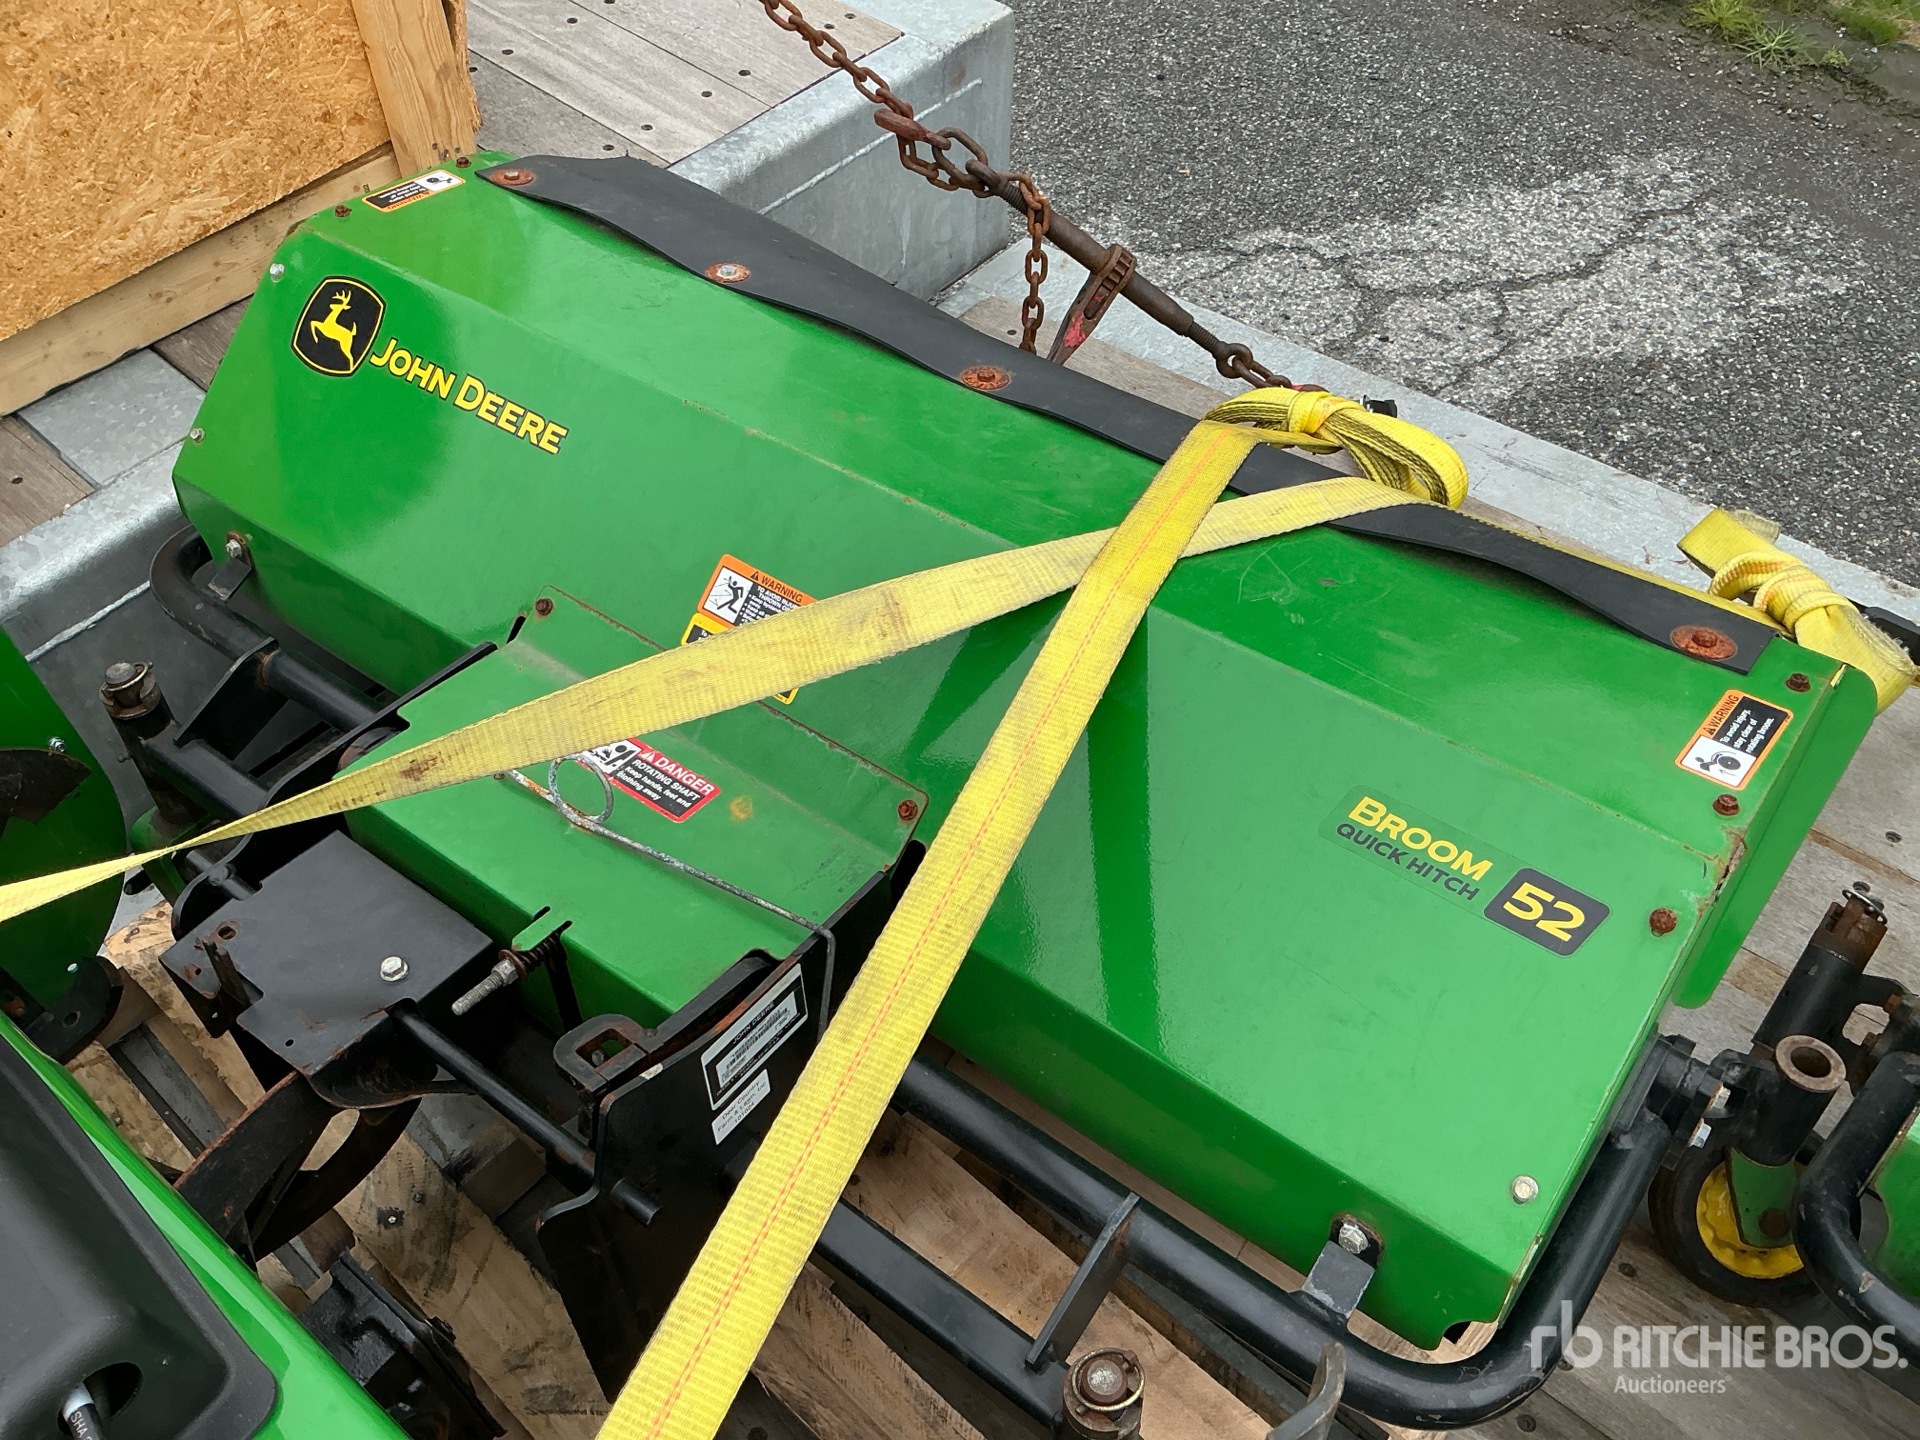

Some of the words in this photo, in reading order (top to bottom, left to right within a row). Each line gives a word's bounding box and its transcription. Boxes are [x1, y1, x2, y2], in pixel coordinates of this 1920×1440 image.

[369, 337, 457, 401] JOHN
[453, 374, 569, 455] DEERE
[761, 575, 803, 603] WARNING
[1709, 694, 1740, 729] WARNING
[1727, 722, 1740, 738] avoid
[1734, 709, 1751, 725] injury,
[1733, 736, 1747, 749] stay
[1741, 724, 1754, 738] clear
[1749, 718, 1758, 726] of
[1746, 733, 1765, 754] rotating
[1757, 718, 1775, 735] broom.
[624, 766, 643, 779] Keep
[642, 776, 663, 792] hands,
[663, 789, 679, 800] feet
[676, 797, 692, 808] and
[632, 759, 673, 785] ROTATING
[671, 782, 701, 801] SHAFT
[643, 788, 662, 801] away
[654, 757, 715, 796] DANGER
[1348, 796, 1494, 881] BROOM
[1336, 823, 1410, 865] QUICK
[1405, 857, 1480, 901] HITCH
[1502, 882, 1586, 942] 52
[70, 1411, 88, 1438] SHA
